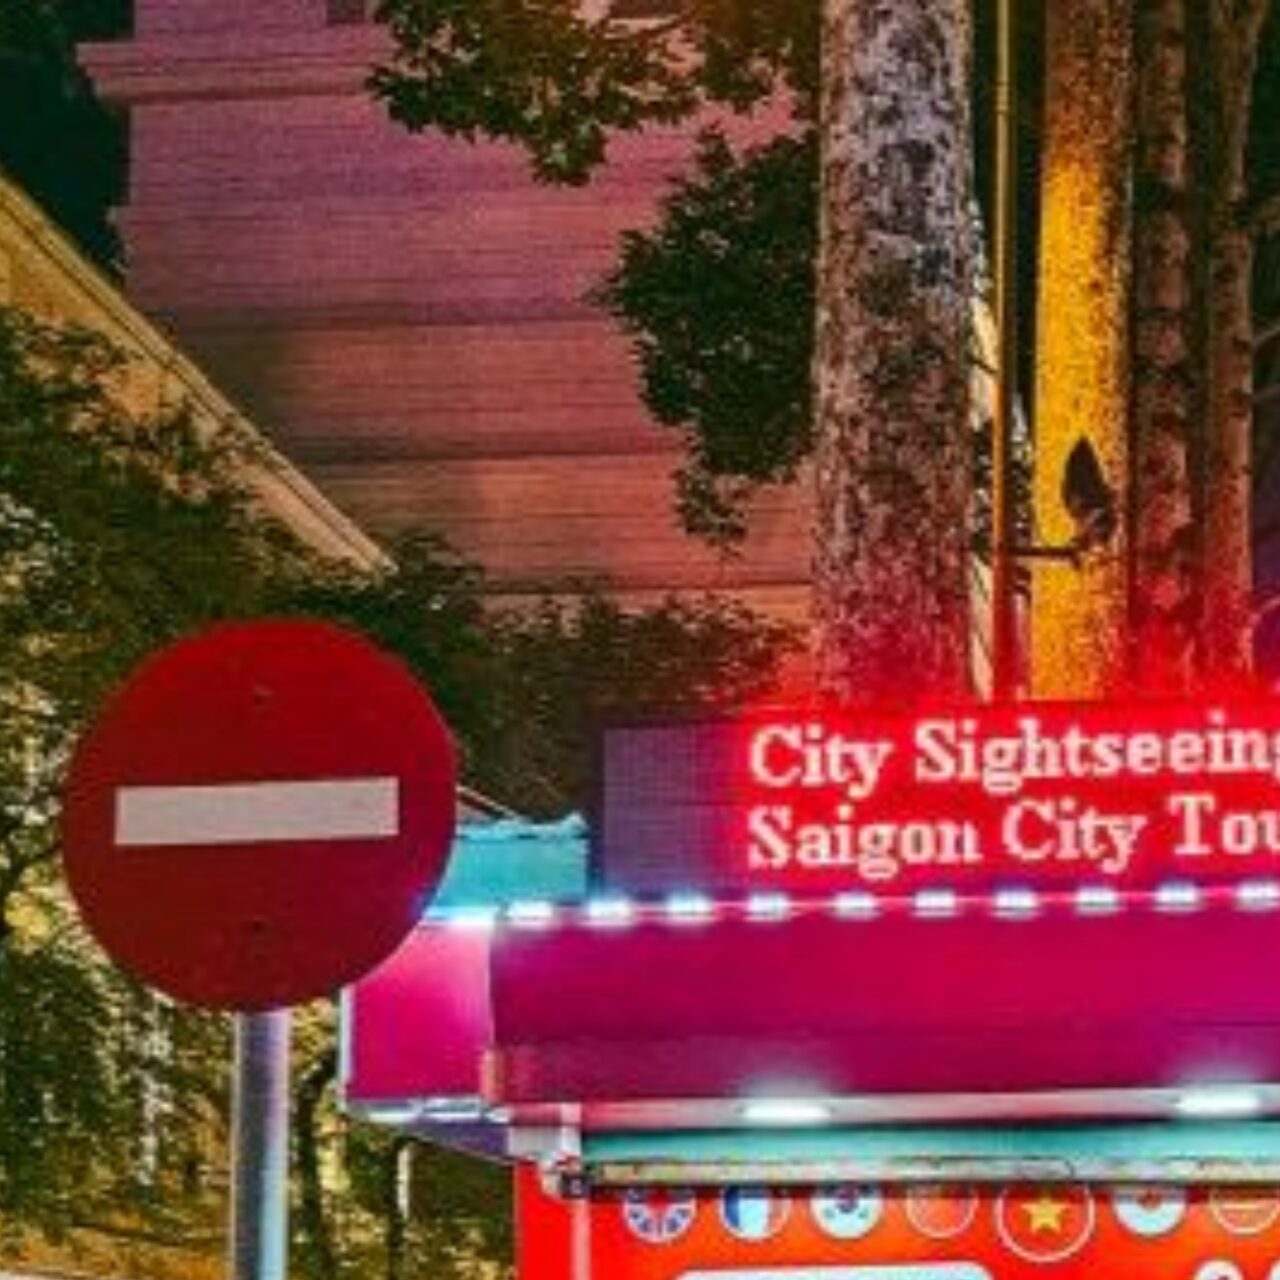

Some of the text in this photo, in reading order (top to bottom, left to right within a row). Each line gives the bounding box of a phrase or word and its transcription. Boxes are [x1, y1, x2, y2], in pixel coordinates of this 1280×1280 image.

[748, 723, 892, 798] City
[747, 803, 982, 878] Saigon
[1001, 797, 1147, 872] City
